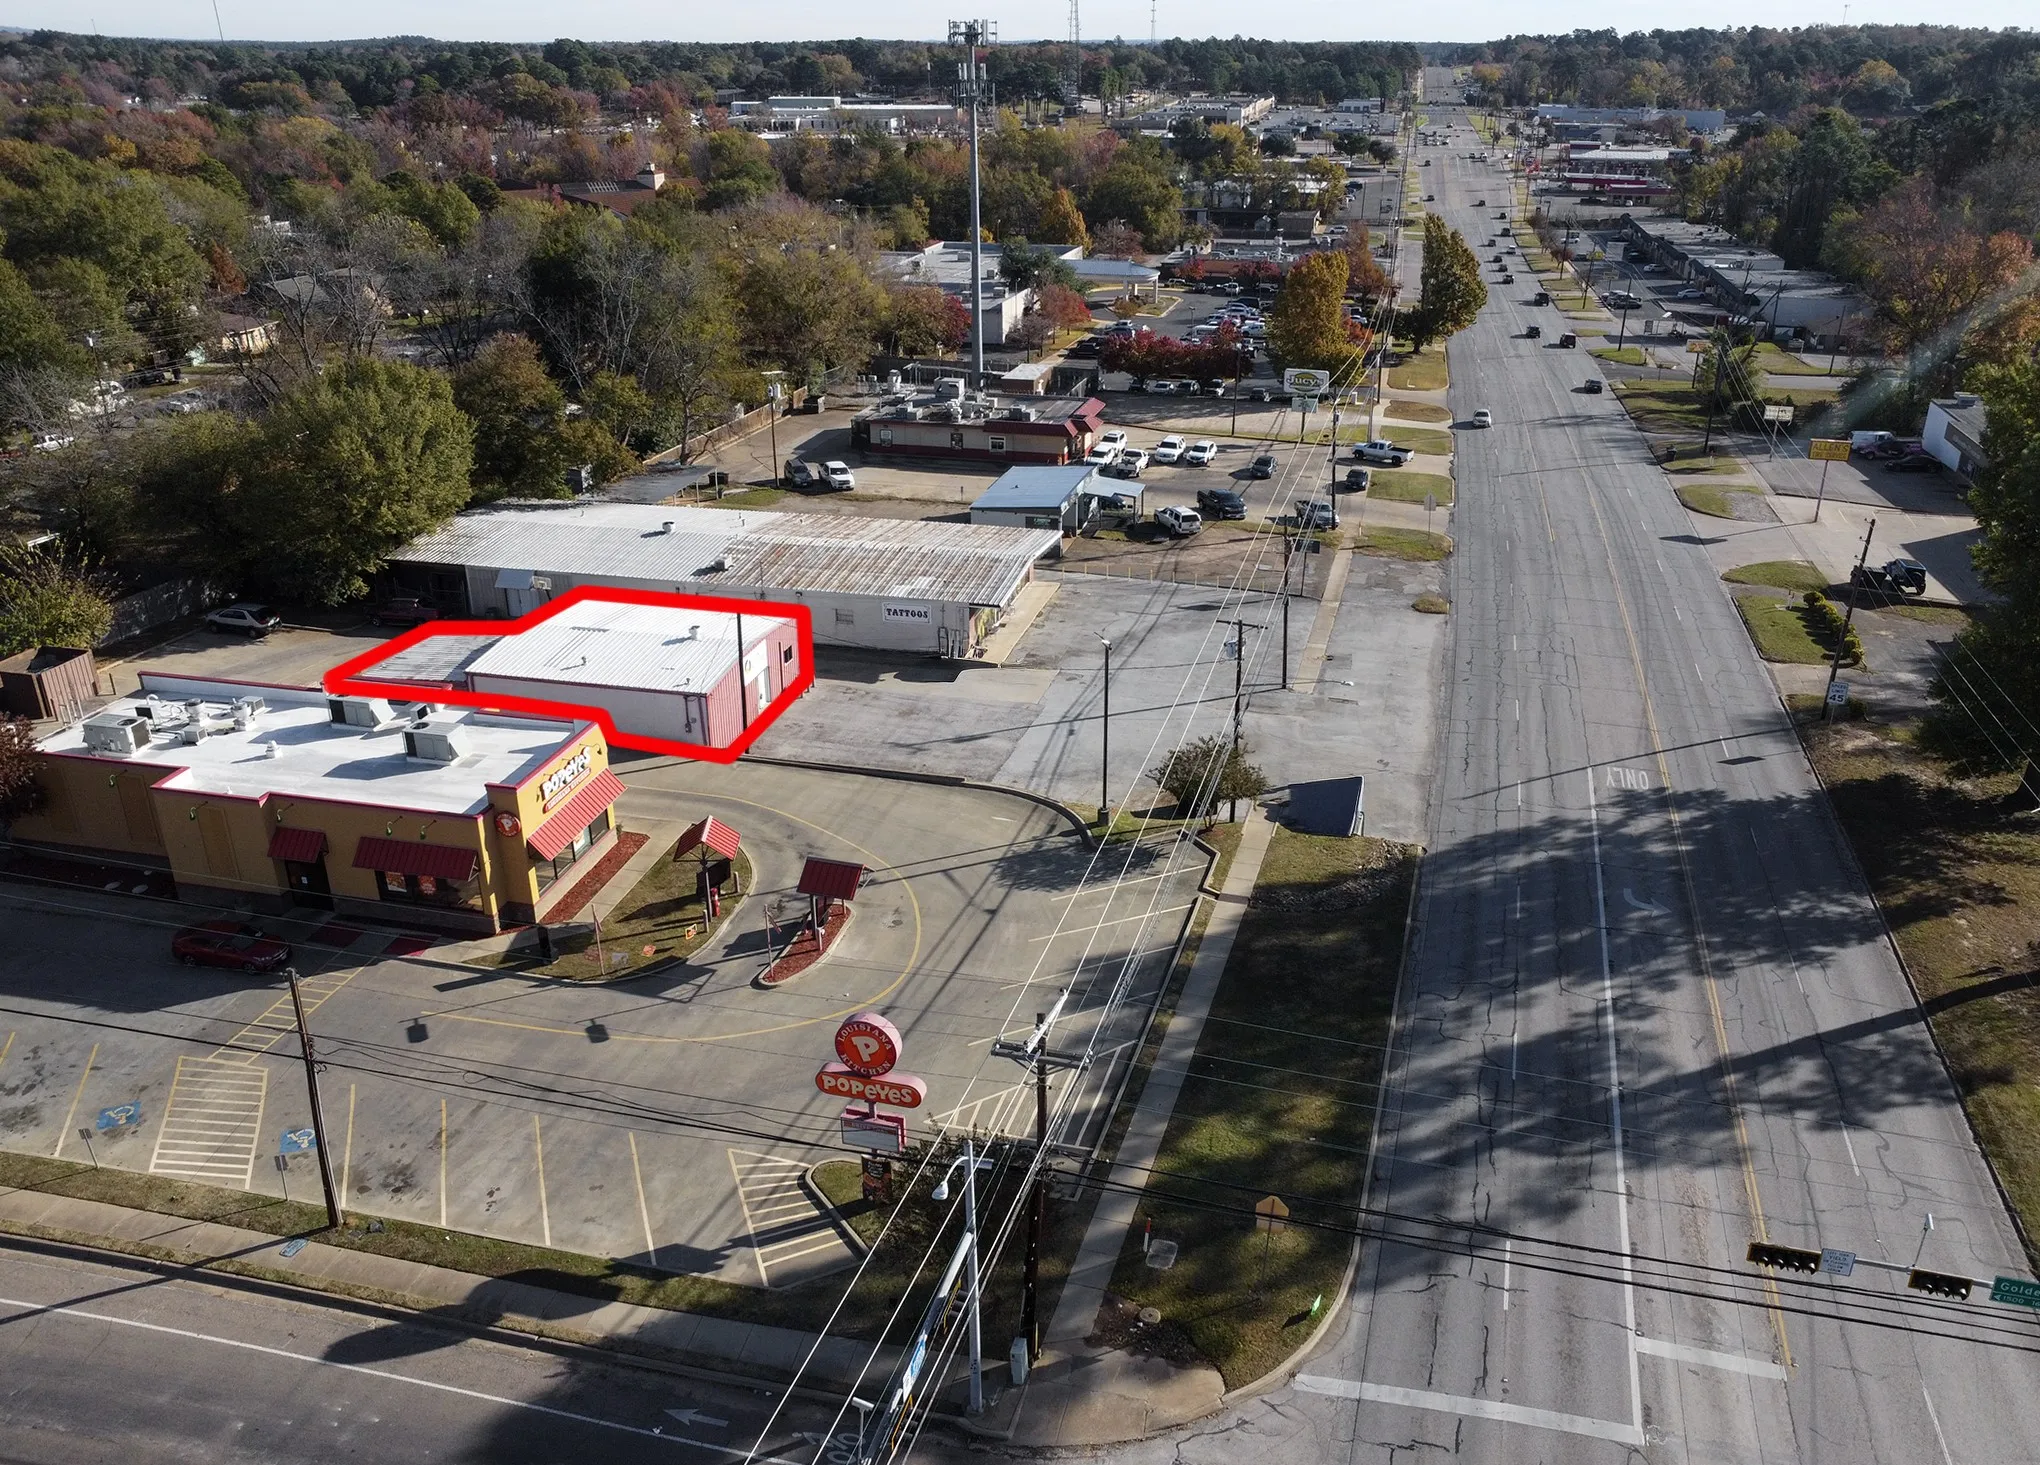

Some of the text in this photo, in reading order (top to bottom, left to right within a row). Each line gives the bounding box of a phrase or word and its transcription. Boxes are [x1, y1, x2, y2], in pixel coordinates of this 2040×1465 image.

[886, 608, 928, 619] TATTOOS
[1829, 694, 1845, 702] 45
[1606, 766, 1649, 790] ONLY
[838, 1023, 892, 1051] LOUISIANA
[852, 1036, 880, 1062] P
[840, 1052, 892, 1076] KITCHEN
